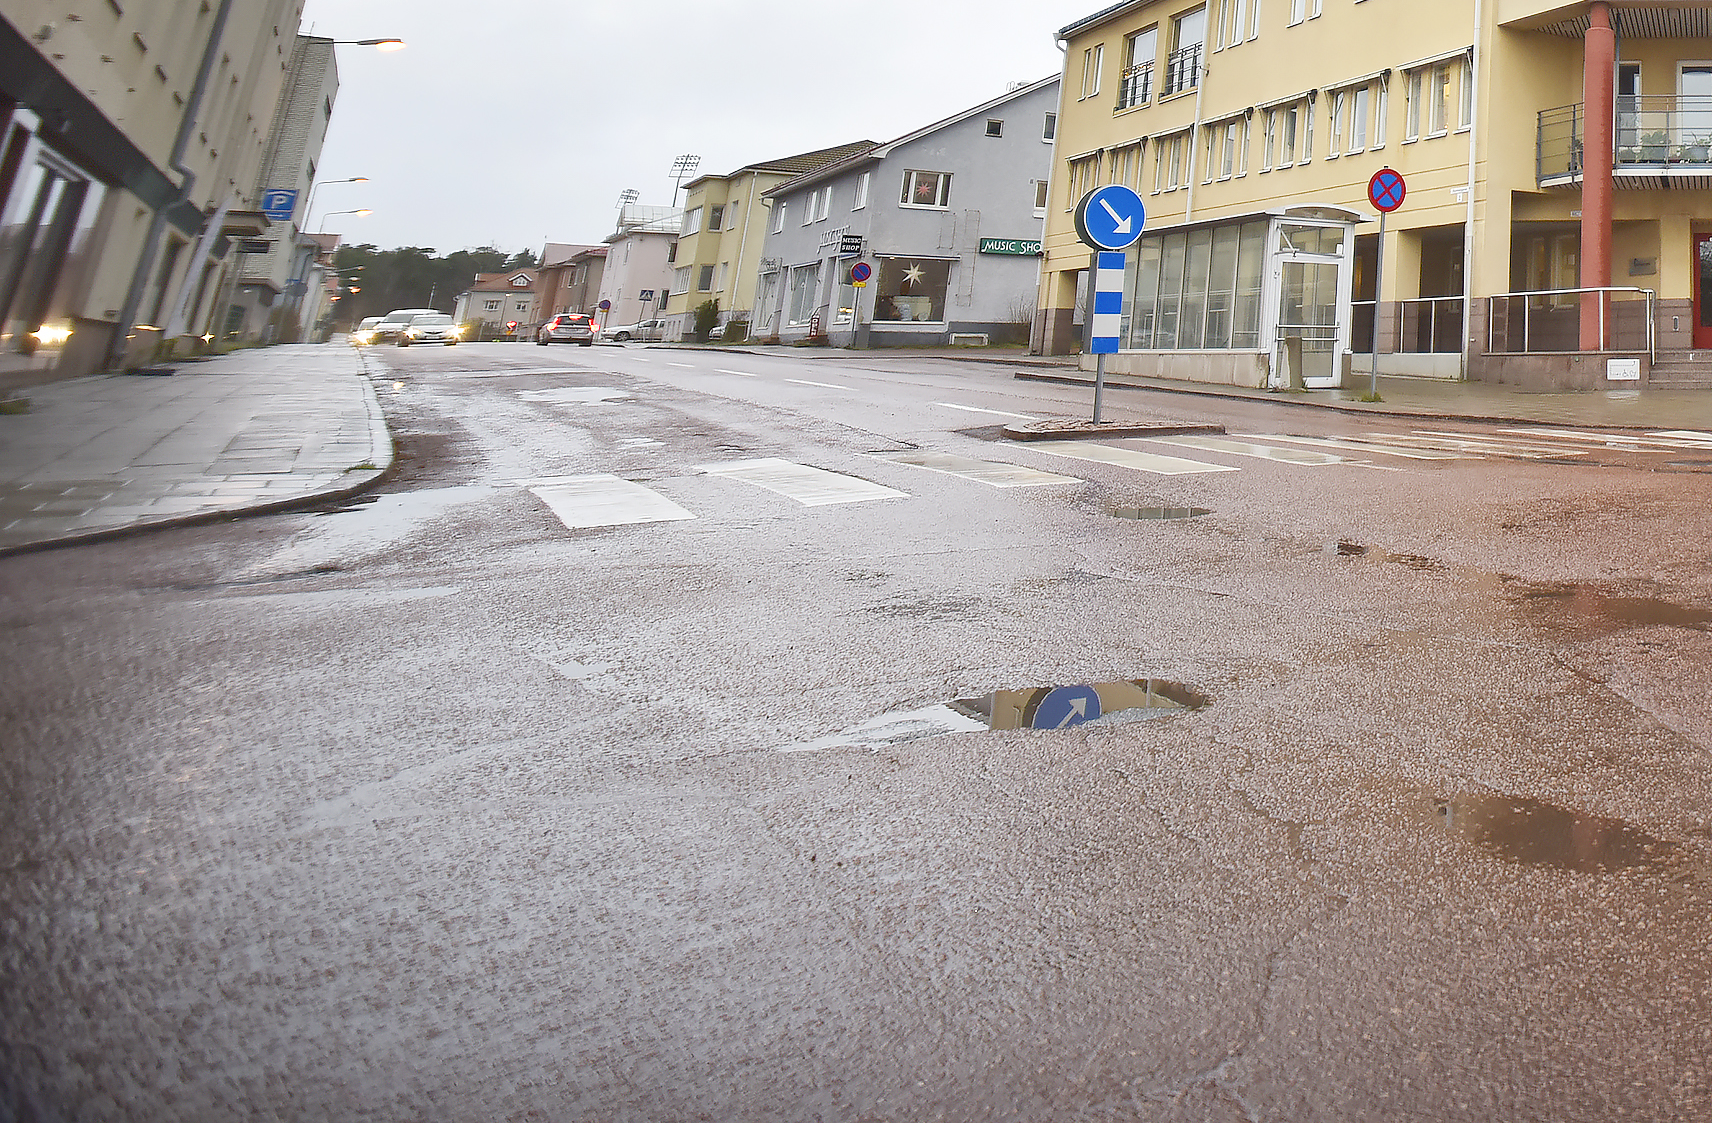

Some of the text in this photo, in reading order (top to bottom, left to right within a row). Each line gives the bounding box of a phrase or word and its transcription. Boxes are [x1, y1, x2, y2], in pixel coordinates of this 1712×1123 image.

[271, 195, 287, 208] P
[981, 241, 1042, 255] MUSIC SHO
